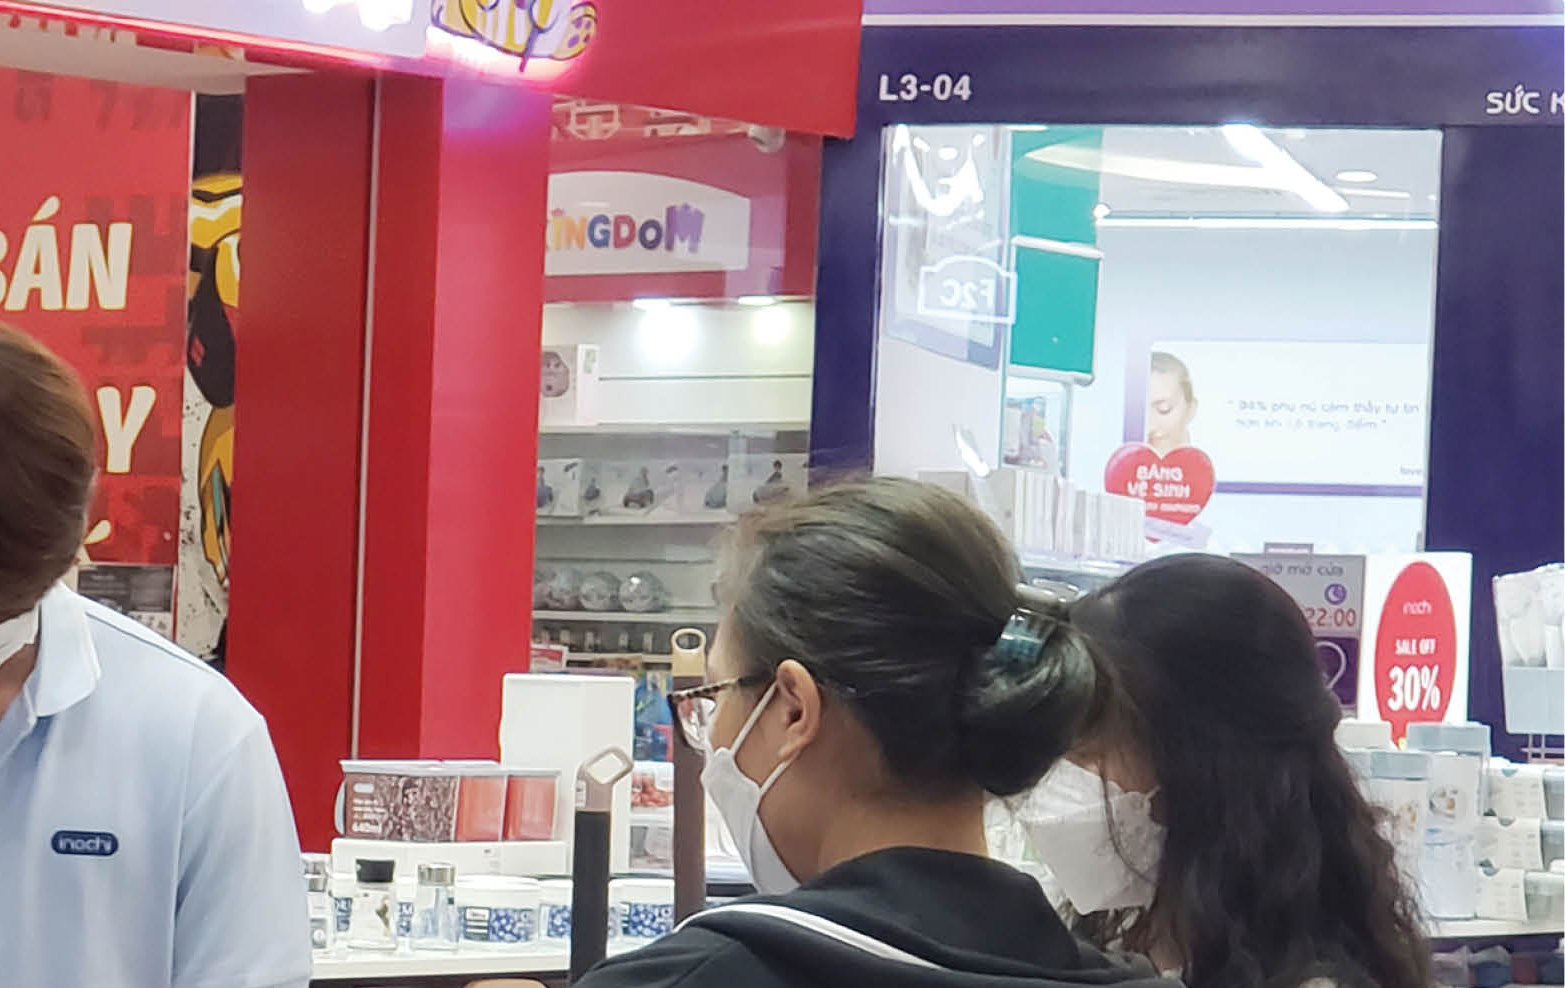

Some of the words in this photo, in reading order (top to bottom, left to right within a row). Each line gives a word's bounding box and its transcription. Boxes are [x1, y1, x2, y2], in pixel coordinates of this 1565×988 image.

[879, 73, 972, 101] L3-04
[1486, 84, 1540, 114] SỨC
[552, 202, 705, 255] INGDOM
[1306, 608, 1356, 628] 22:00
[1395, 638, 1417, 655] SALE
[1419, 638, 1436, 655] OFF
[1387, 665, 1441, 711] 30%
[59, 836, 112, 851] inochi
